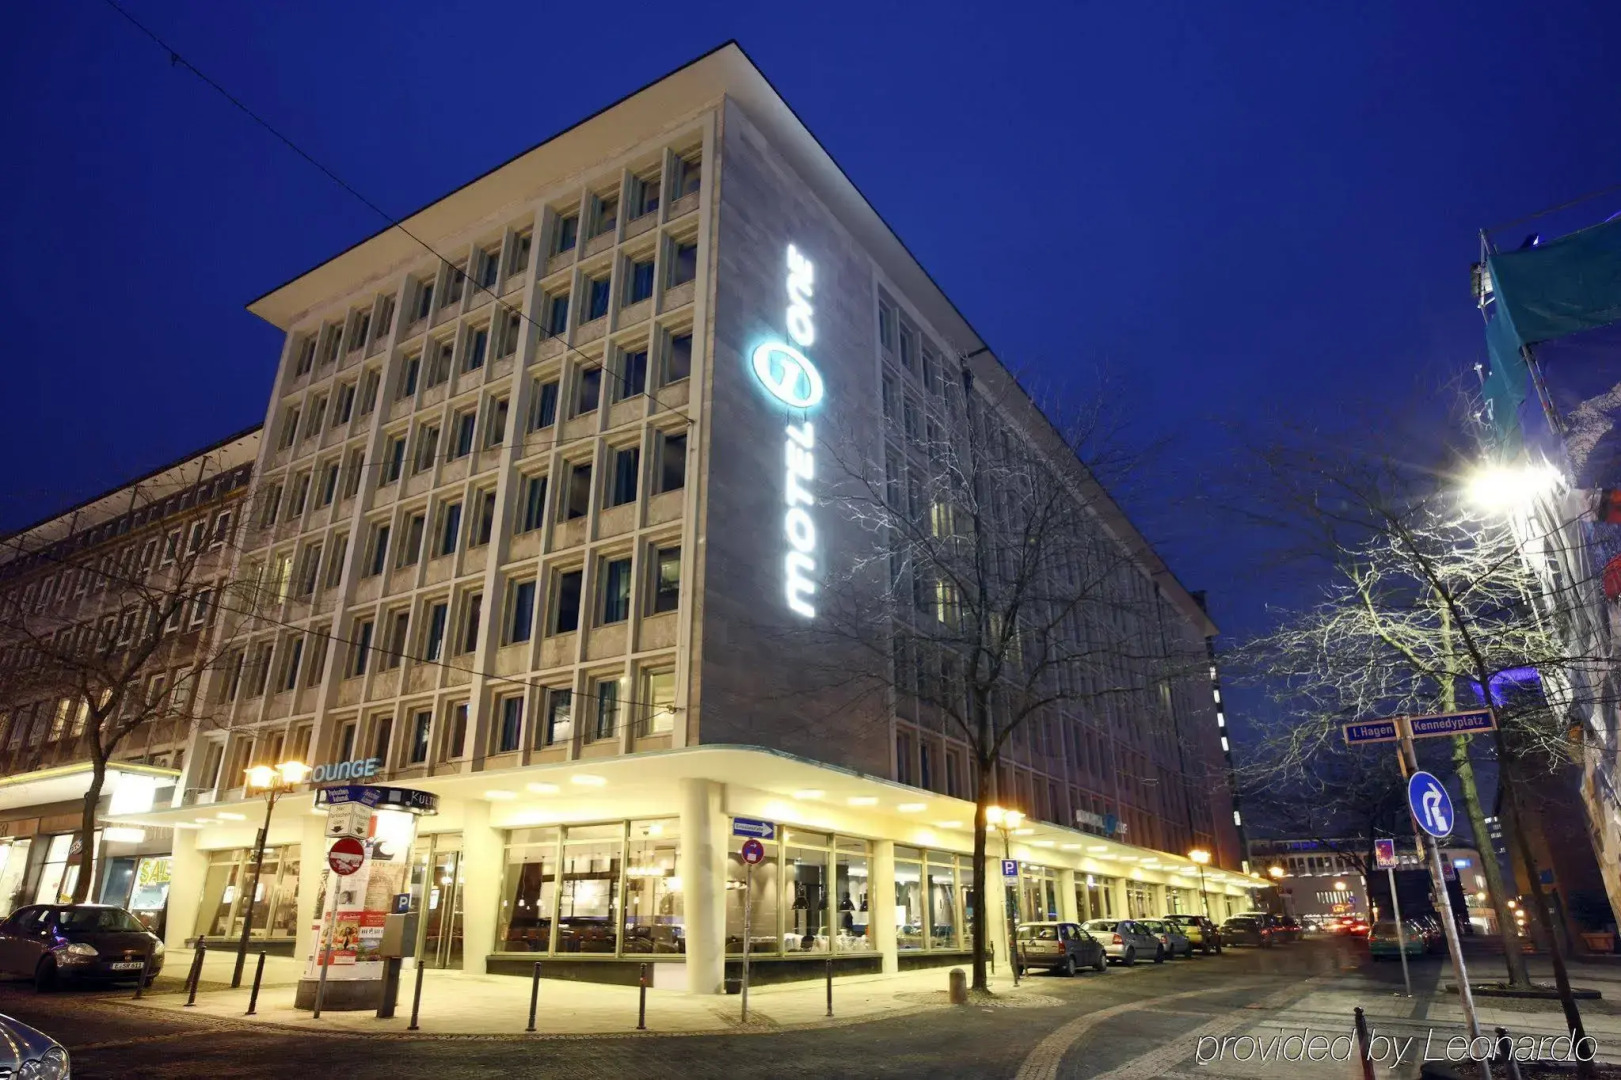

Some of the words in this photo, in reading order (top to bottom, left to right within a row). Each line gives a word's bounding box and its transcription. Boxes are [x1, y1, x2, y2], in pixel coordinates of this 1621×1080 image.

[786, 243, 814, 347] ONE
[785, 421, 816, 618] MOTEL
[1413, 715, 1484, 732] Kennedyplatz
[1361, 726, 1393, 739] Hagen
[410, 791, 439, 808] KULTU
[1004, 861, 1015, 875] P
[399, 896, 408, 909] P
